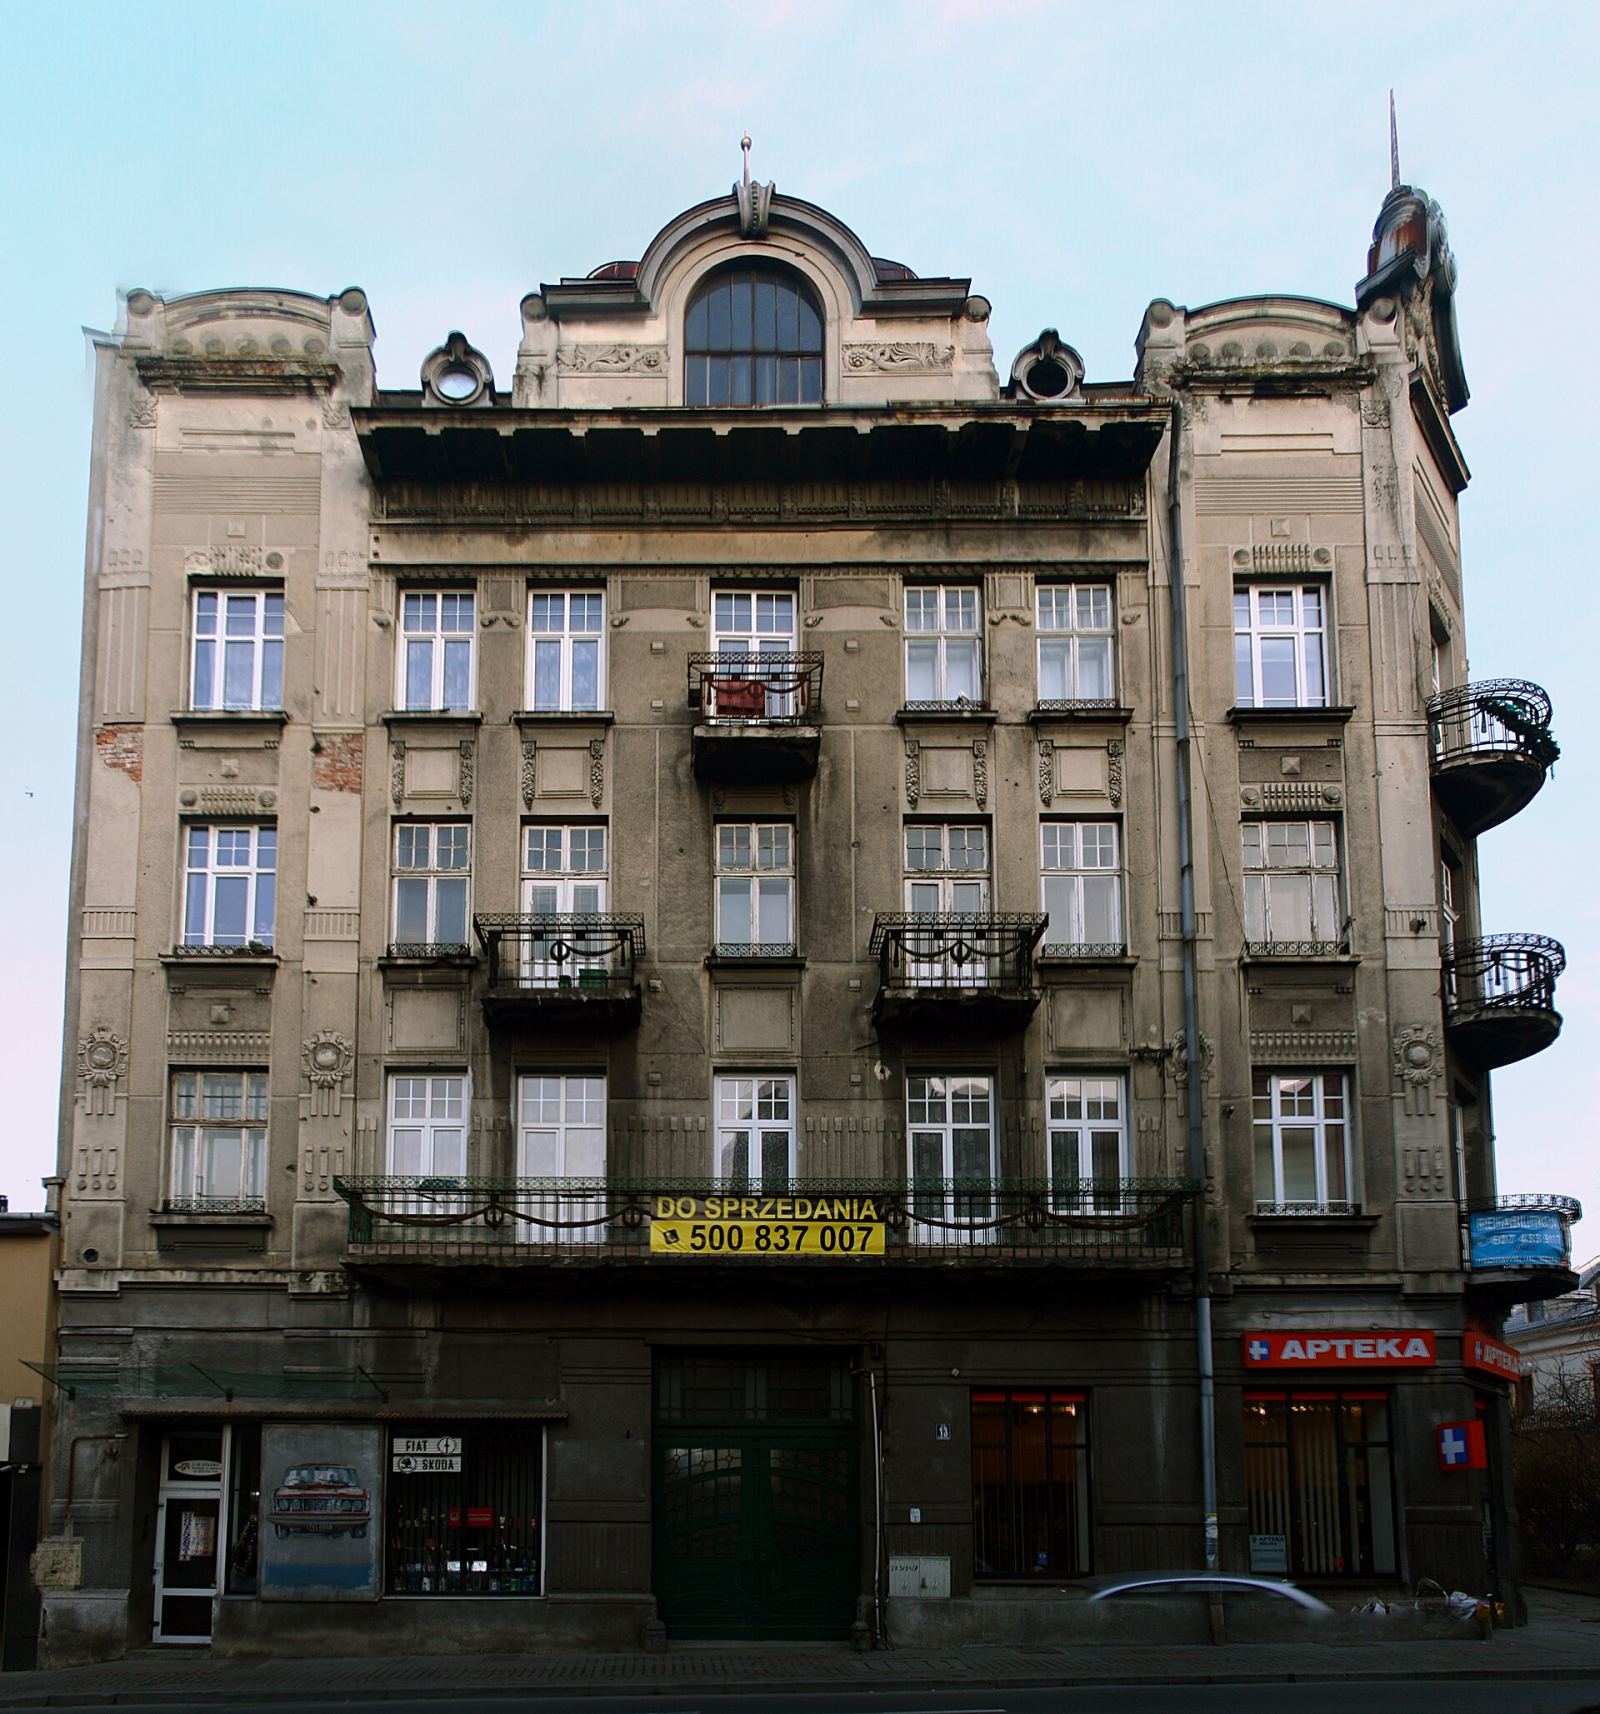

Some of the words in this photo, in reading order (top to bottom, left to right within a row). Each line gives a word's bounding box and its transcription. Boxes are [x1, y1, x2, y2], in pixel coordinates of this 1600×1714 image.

[656, 1196, 697, 1219] DO
[704, 1197, 879, 1220] SPRZEDANIA
[690, 1224, 744, 1251] 500
[754, 1225, 809, 1251] 837
[819, 1225, 874, 1252] 007
[1280, 1338, 1431, 1360] APTEKA
[405, 1440, 428, 1452] FIAT
